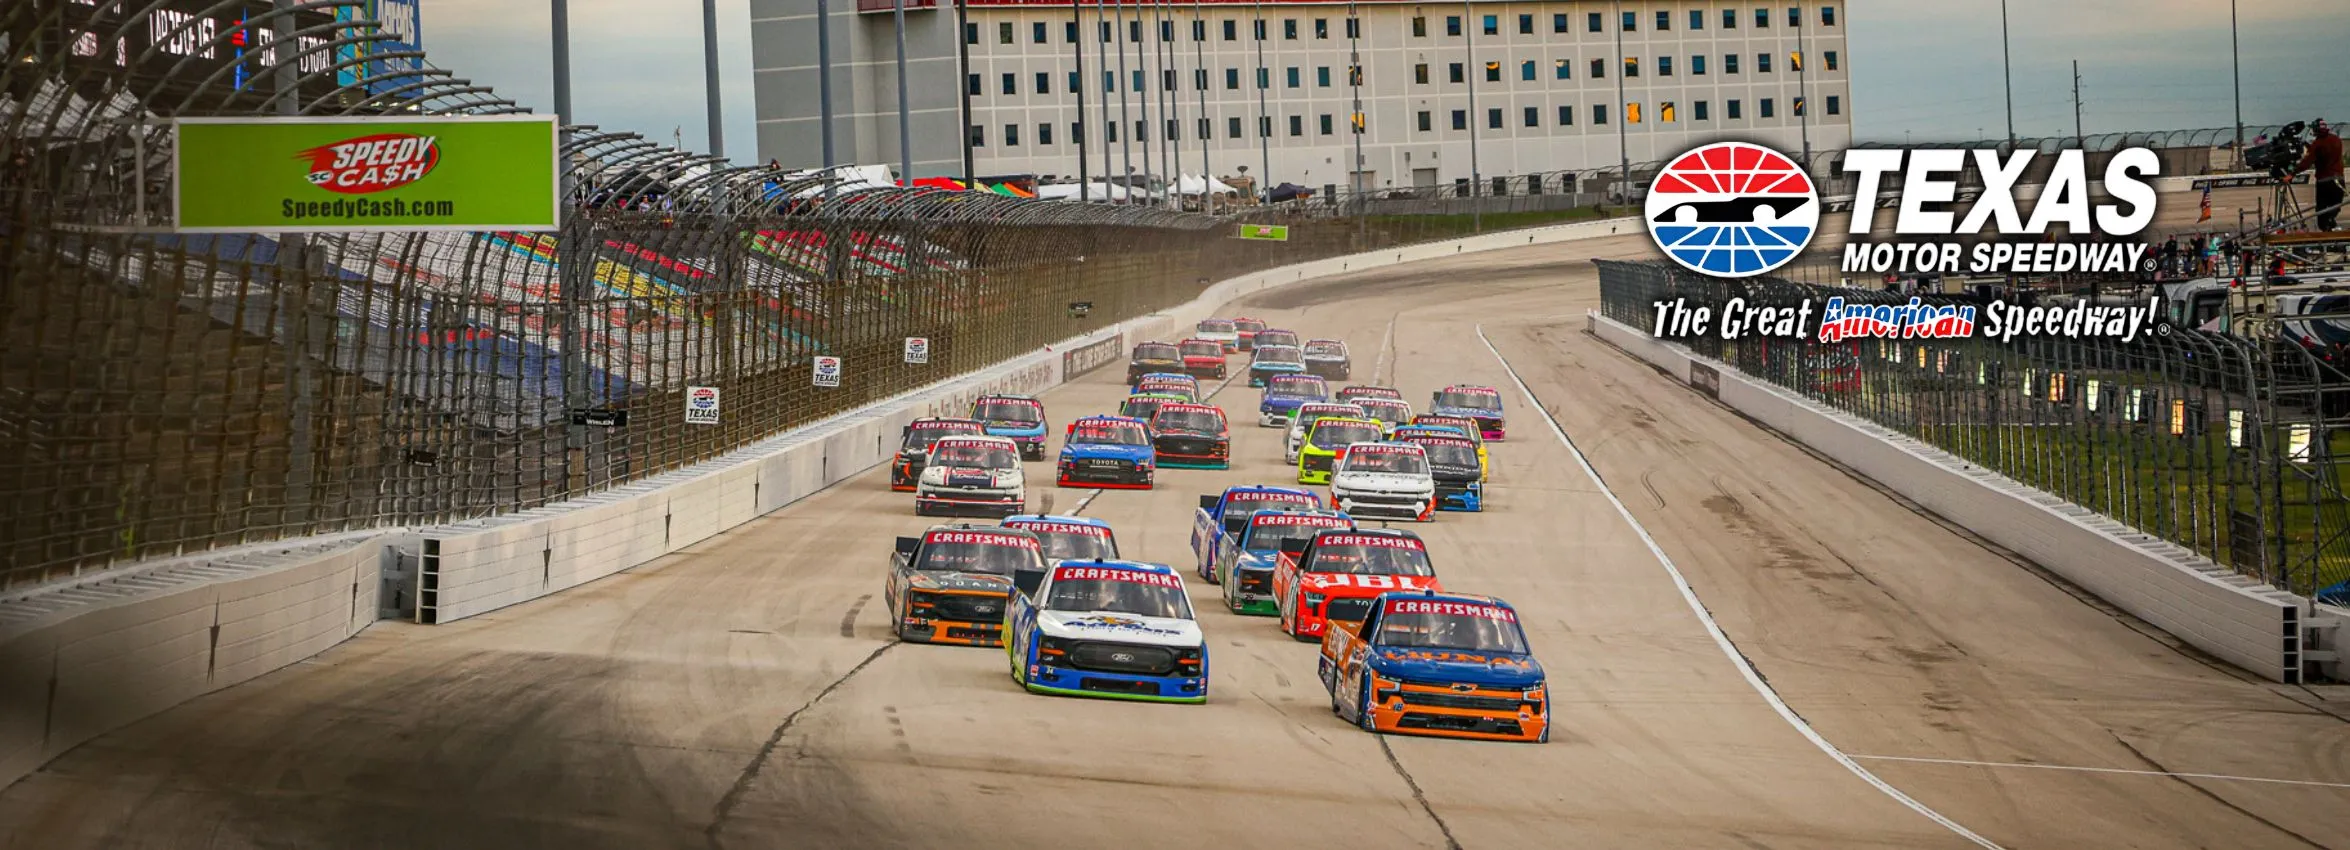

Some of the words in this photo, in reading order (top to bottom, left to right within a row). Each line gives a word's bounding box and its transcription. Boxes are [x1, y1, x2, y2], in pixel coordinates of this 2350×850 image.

[329, 136, 436, 169] SPEEDY
[309, 172, 330, 182] SC
[337, 162, 426, 187] CA$H
[282, 198, 453, 219] SpeedyCash.com
[907, 352, 927, 360] TEXAS
[815, 374, 839, 383] TEXAS
[689, 408, 718, 418] TEXAS
[915, 422, 977, 430] CRAFTSMAN
[1080, 420, 1141, 428] CRAFTSMAN
[943, 440, 1010, 450] CRAFTSMAN
[1355, 446, 1419, 455] CRAFTSMAN
[1234, 493, 1312, 505] CRAFTSMAN
[1258, 516, 1343, 528] CRAFTSMAN
[1012, 522, 1102, 537] CRAFTSMAN
[933, 533, 1029, 548] CRAFTSMAN
[1324, 536, 1417, 549] CRAFTSMAN
[1064, 568, 1172, 586] CRAFTSMAN
[1318, 574, 1430, 590] JBL
[1395, 602, 1506, 620] CRAFTSMAN
